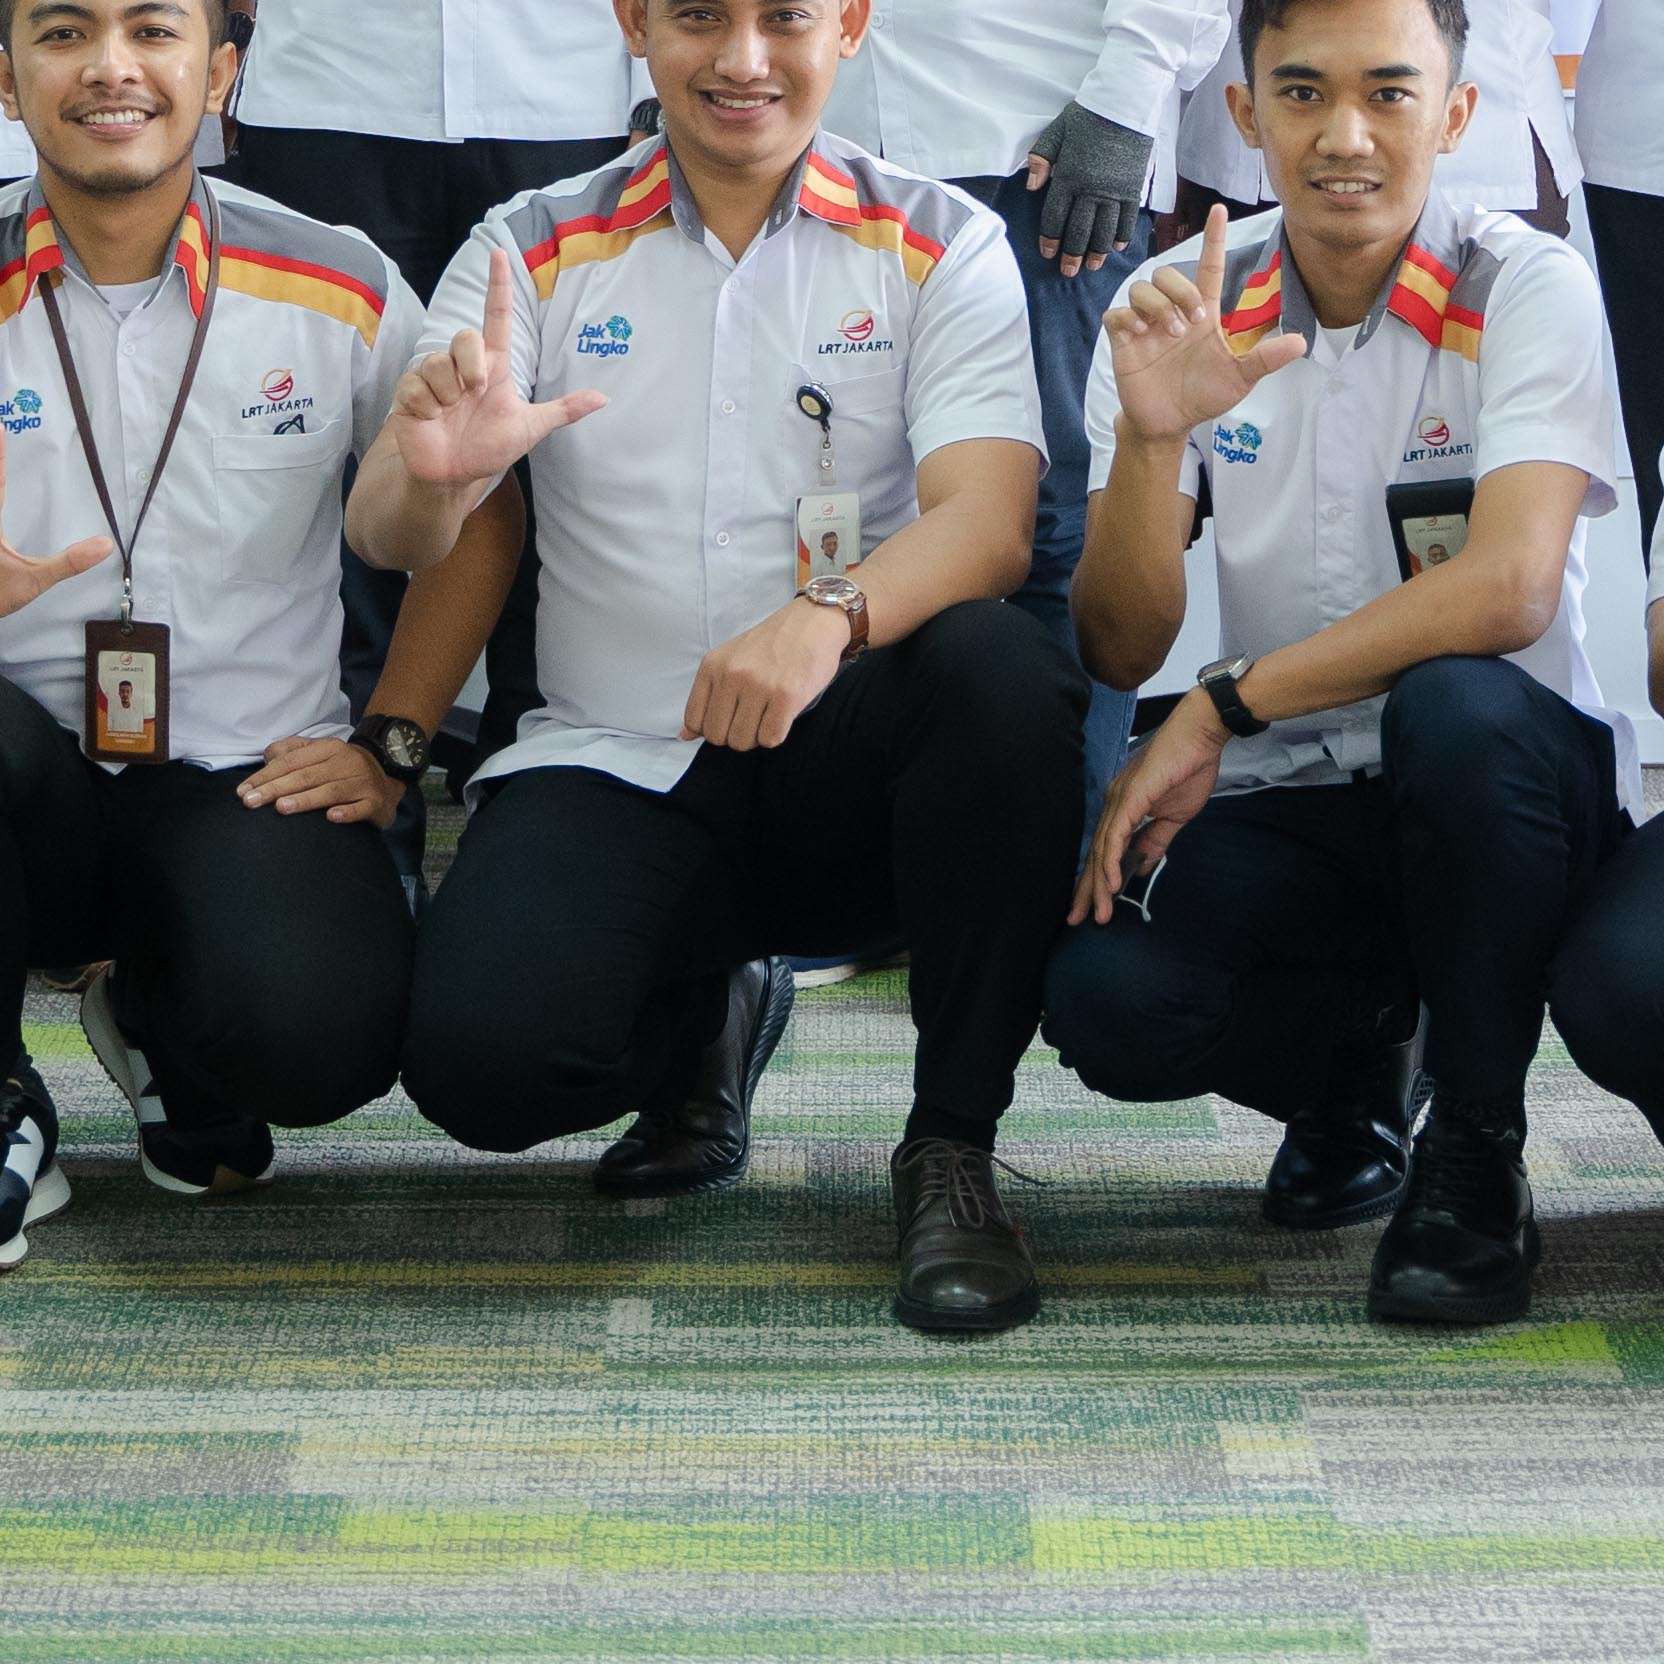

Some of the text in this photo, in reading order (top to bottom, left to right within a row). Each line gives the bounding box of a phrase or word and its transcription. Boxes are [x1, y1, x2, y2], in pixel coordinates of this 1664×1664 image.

[577, 323, 606, 339] Jak
[577, 338, 629, 358] Lingko
[817, 340, 894, 354] LRT JAKARTA
[241, 396, 314, 419] LRT JAKARTA
[1402, 443, 1473, 463] LRT JAKART
